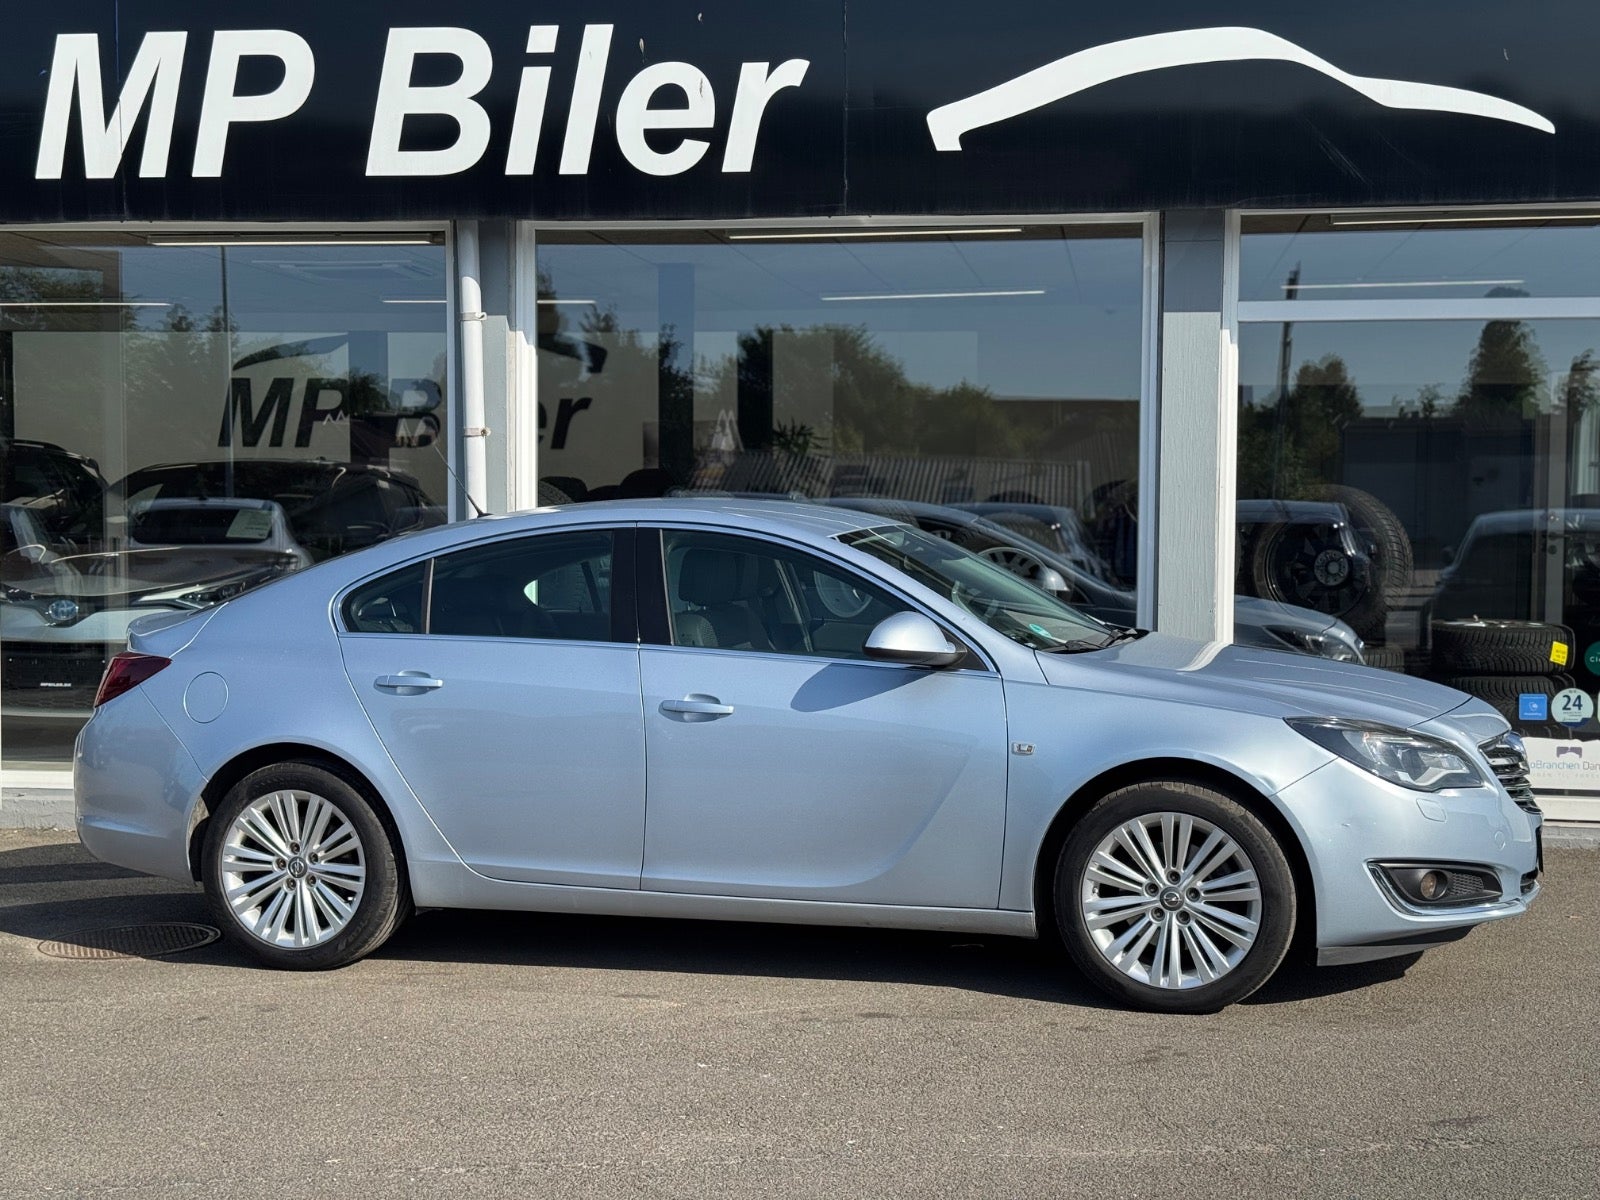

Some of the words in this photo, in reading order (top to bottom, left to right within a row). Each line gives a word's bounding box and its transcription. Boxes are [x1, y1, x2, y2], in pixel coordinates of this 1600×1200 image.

[35, 30, 315, 180] MP
[365, 24, 811, 178] Biler
[217, 377, 350, 448] MP
[1589, 655, 1600, 664] Cl
[1562, 694, 1583, 711] 24
[1530, 759, 1580, 770] oBranchen
